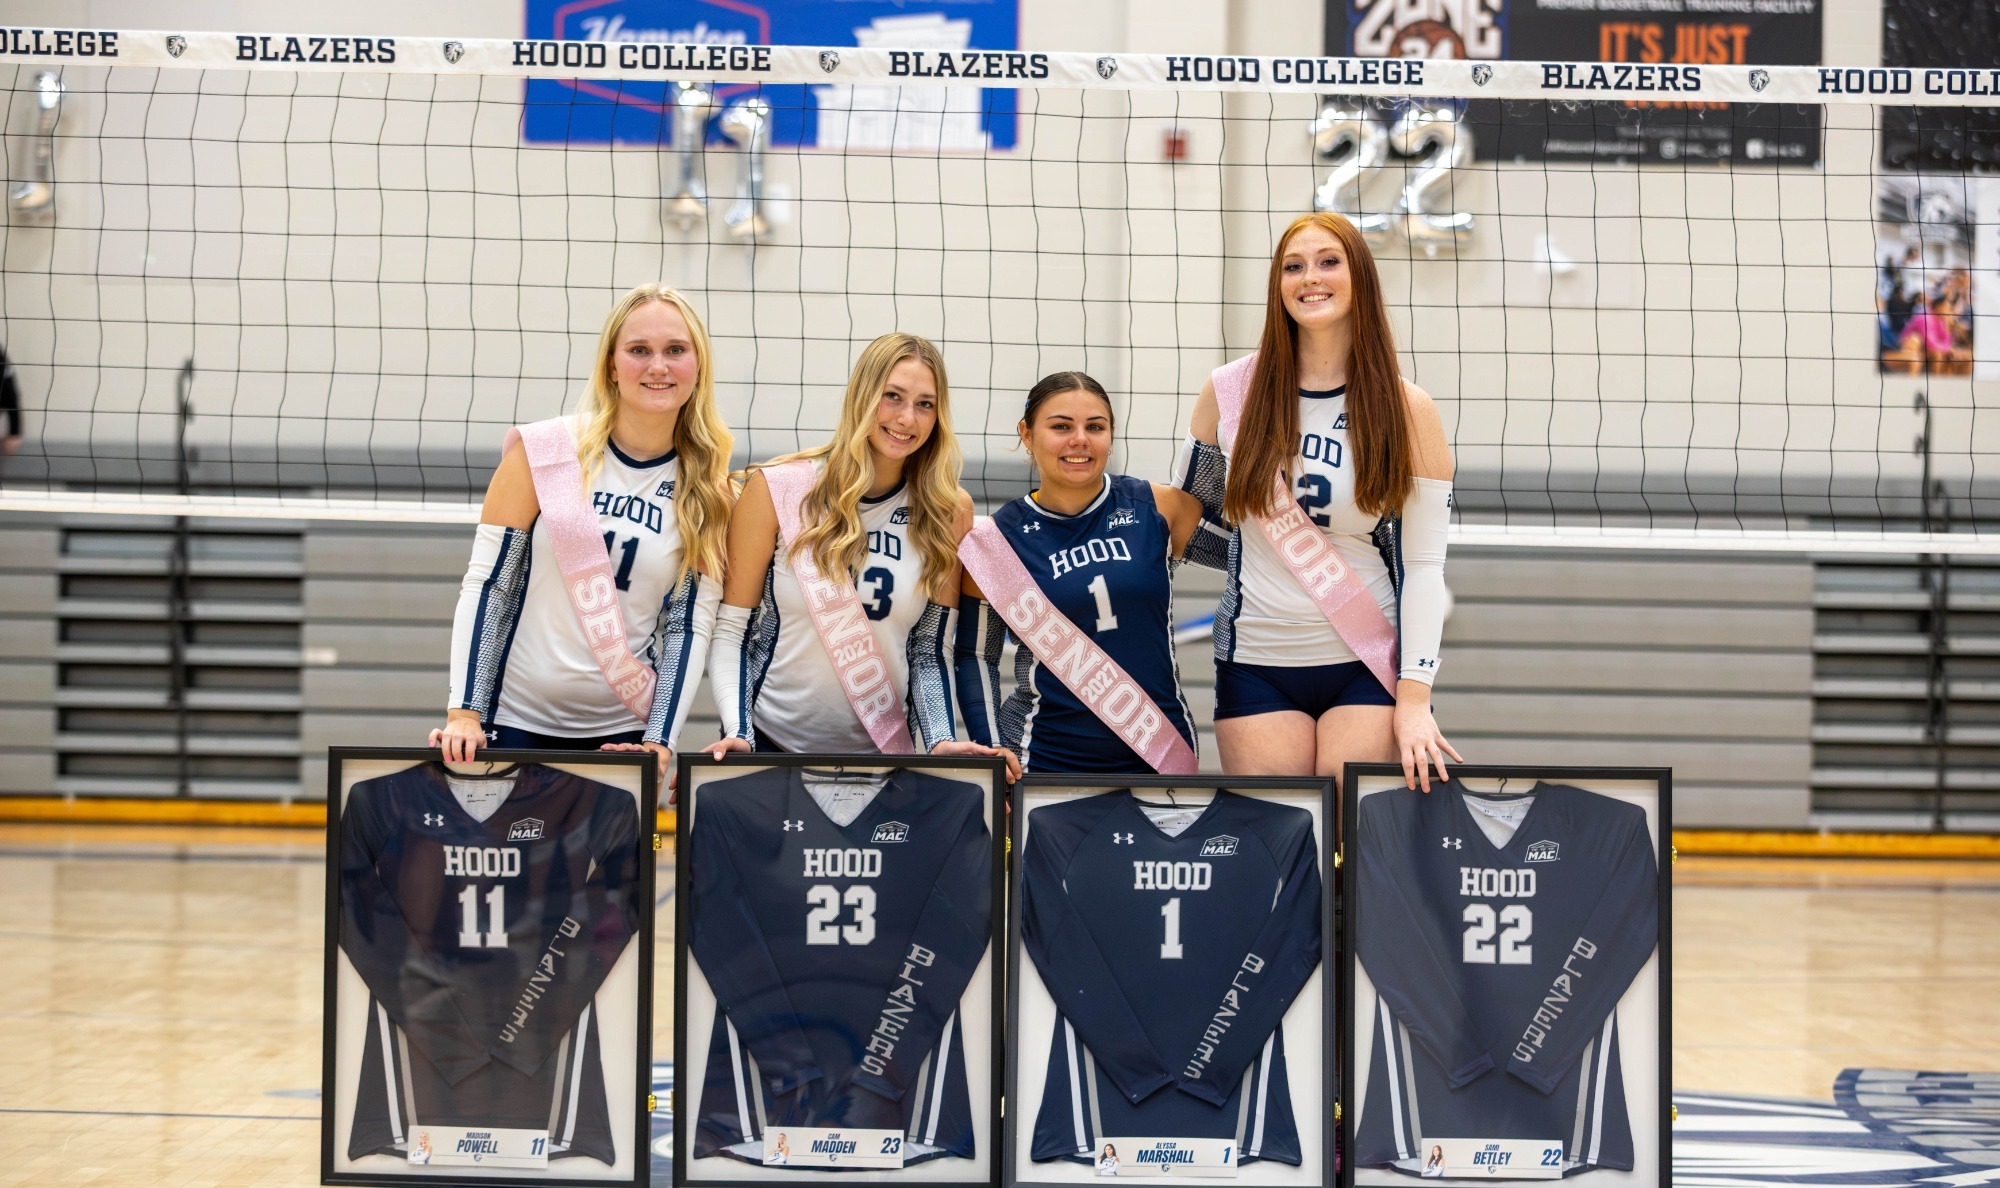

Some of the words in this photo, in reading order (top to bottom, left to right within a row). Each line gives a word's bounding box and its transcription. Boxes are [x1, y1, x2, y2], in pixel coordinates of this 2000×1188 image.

[236, 35, 396, 63] BLAZERS
[512, 41, 606, 68] HOOD
[619, 45, 771, 72] COLLEGE
[1600, 22, 1664, 62] IT'S
[1670, 23, 1750, 64] JUST
[888, 51, 1049, 79] BLAZERS
[1166, 57, 1260, 84] HOOD
[1272, 59, 1424, 86] COLLEGE
[1541, 64, 1701, 92] BLAZERS
[1818, 68, 1912, 94] HOOD
[592, 491, 663, 535] HOOD
[1108, 514, 1134, 530] MAC
[1265, 508, 1305, 542] 2027
[1048, 537, 1132, 580] HOOD
[1088, 574, 1119, 632] 1
[833, 635, 875, 668] 2027
[615, 668, 650, 701] 2027
[1081, 664, 1119, 705] 2027
[511, 829, 540, 839] MAC
[874, 832, 905, 841] MAC
[443, 845, 521, 877] HOOD
[803, 848, 882, 877] HOOD
[1203, 845, 1234, 855] MAC
[1527, 851, 1556, 861] MAC
[1133, 861, 1212, 890] HOOD
[1460, 867, 1536, 898] HOOD
[458, 884, 509, 948] 11
[806, 885, 877, 945] 23
[1160, 898, 1183, 959] 1
[1463, 903, 1533, 964] 22
[861, 943, 936, 1077] BLAZERS
[1513, 936, 1598, 1063] BLAZERS
[456, 1139, 498, 1154] POWELL
[531, 1138, 546, 1155] 11
[811, 1140, 856, 1153] MADDEN
[880, 1137, 901, 1154] 23
[1136, 1150, 1194, 1163] MARSHALL
[1223, 1146, 1231, 1164] 1
[1473, 1152, 1512, 1165] BETLEY
[1541, 1148, 1562, 1166] 22
